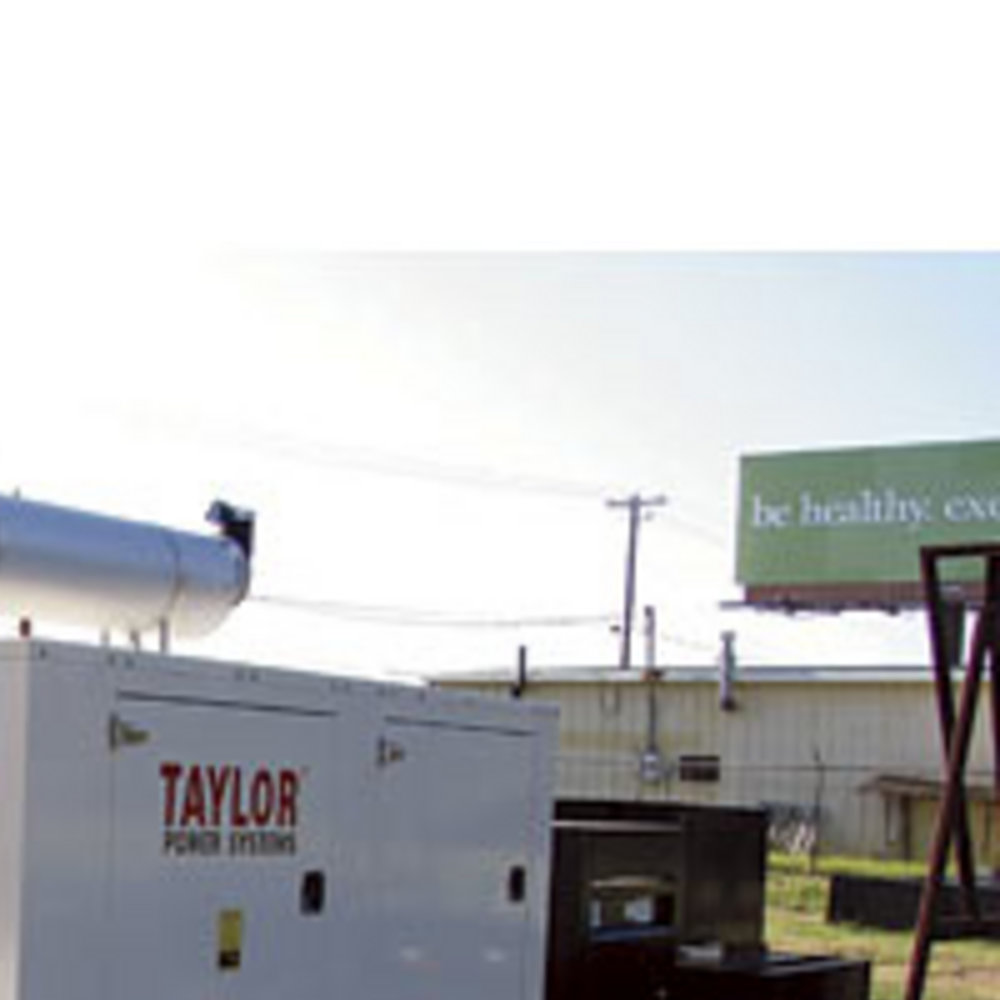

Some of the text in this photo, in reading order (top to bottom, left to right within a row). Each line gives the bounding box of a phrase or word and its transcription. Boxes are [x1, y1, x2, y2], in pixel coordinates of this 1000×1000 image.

[753, 494, 791, 527] be
[160, 761, 298, 827] TAYLOR
[163, 829, 222, 856] POWER
